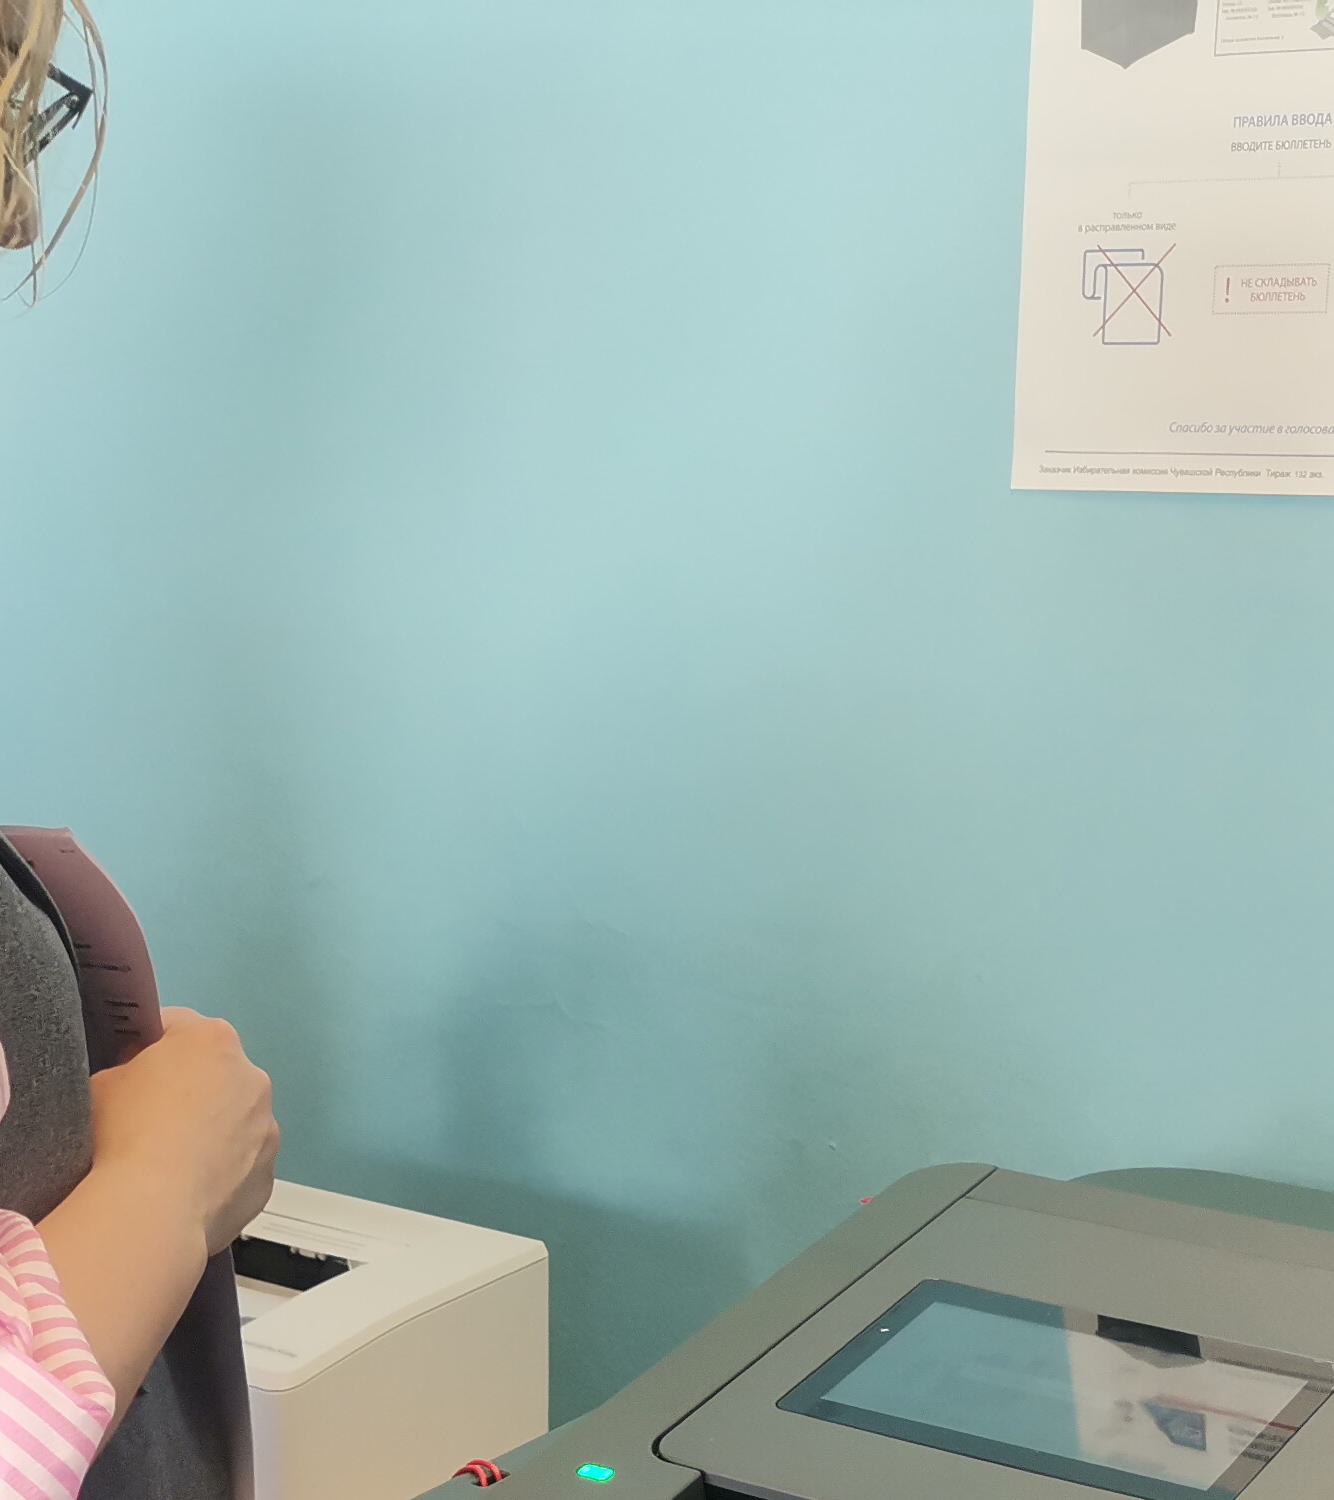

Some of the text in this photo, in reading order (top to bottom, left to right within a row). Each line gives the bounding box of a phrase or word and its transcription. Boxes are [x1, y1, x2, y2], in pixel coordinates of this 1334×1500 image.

[1233, 112, 1332, 128] ПРАВИЛА ВВОДА
[1230, 139, 1332, 152] ВВОДИТЕ БЮЛЛЕТЕНЬ
[1085, 223, 1154, 234] расправленном
[1155, 222, 1177, 232] виде
[1240, 277, 1318, 288] НЕ СКЛАДЫВАТЬ
[1250, 292, 1306, 302] БЮЛЛЕТЕНЬ
[1169, 422, 1213, 434] Спасибо
[1214, 424, 1227, 434] за
[1228, 424, 1276, 436] участие
[1277, 424, 1283, 434] в
[1073, 465, 1130, 476] Избирательная
[1170, 467, 1213, 478] Чувашской
[1214, 467, 1261, 479] Республики
[1266, 468, 1291, 480] Тираж
